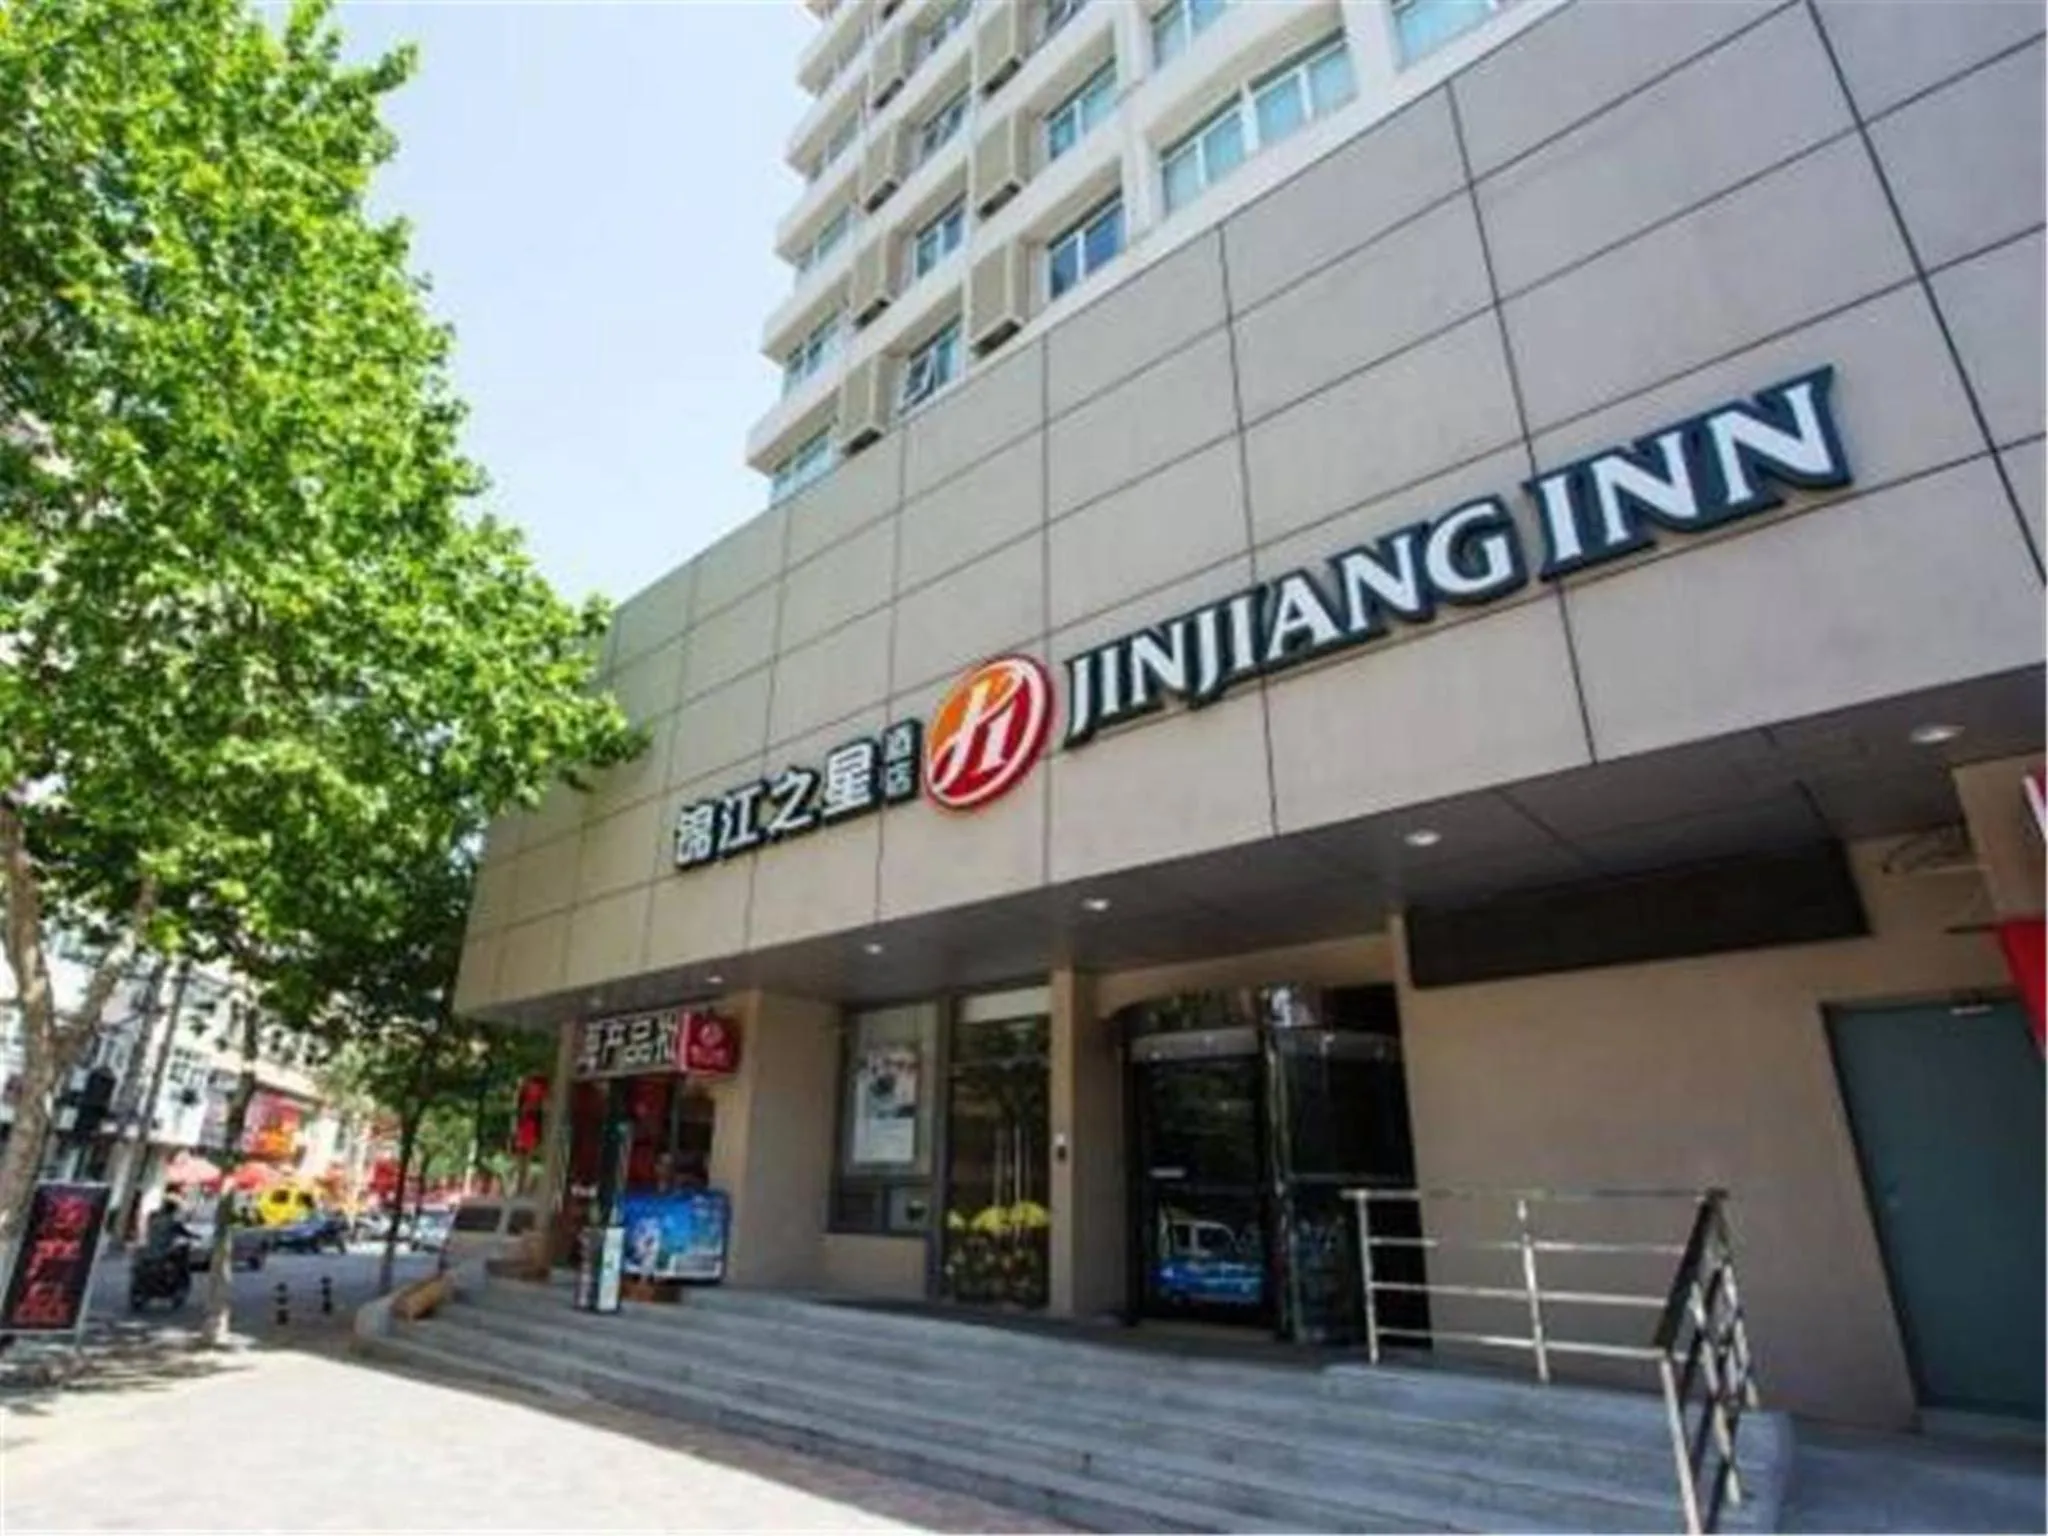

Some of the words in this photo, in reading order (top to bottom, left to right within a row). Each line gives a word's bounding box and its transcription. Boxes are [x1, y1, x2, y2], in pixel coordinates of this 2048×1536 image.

[1064, 497, 1516, 740] JINJIANG
[1540, 376, 1840, 570] INN
[674, 741, 876, 866] 锦江之星
